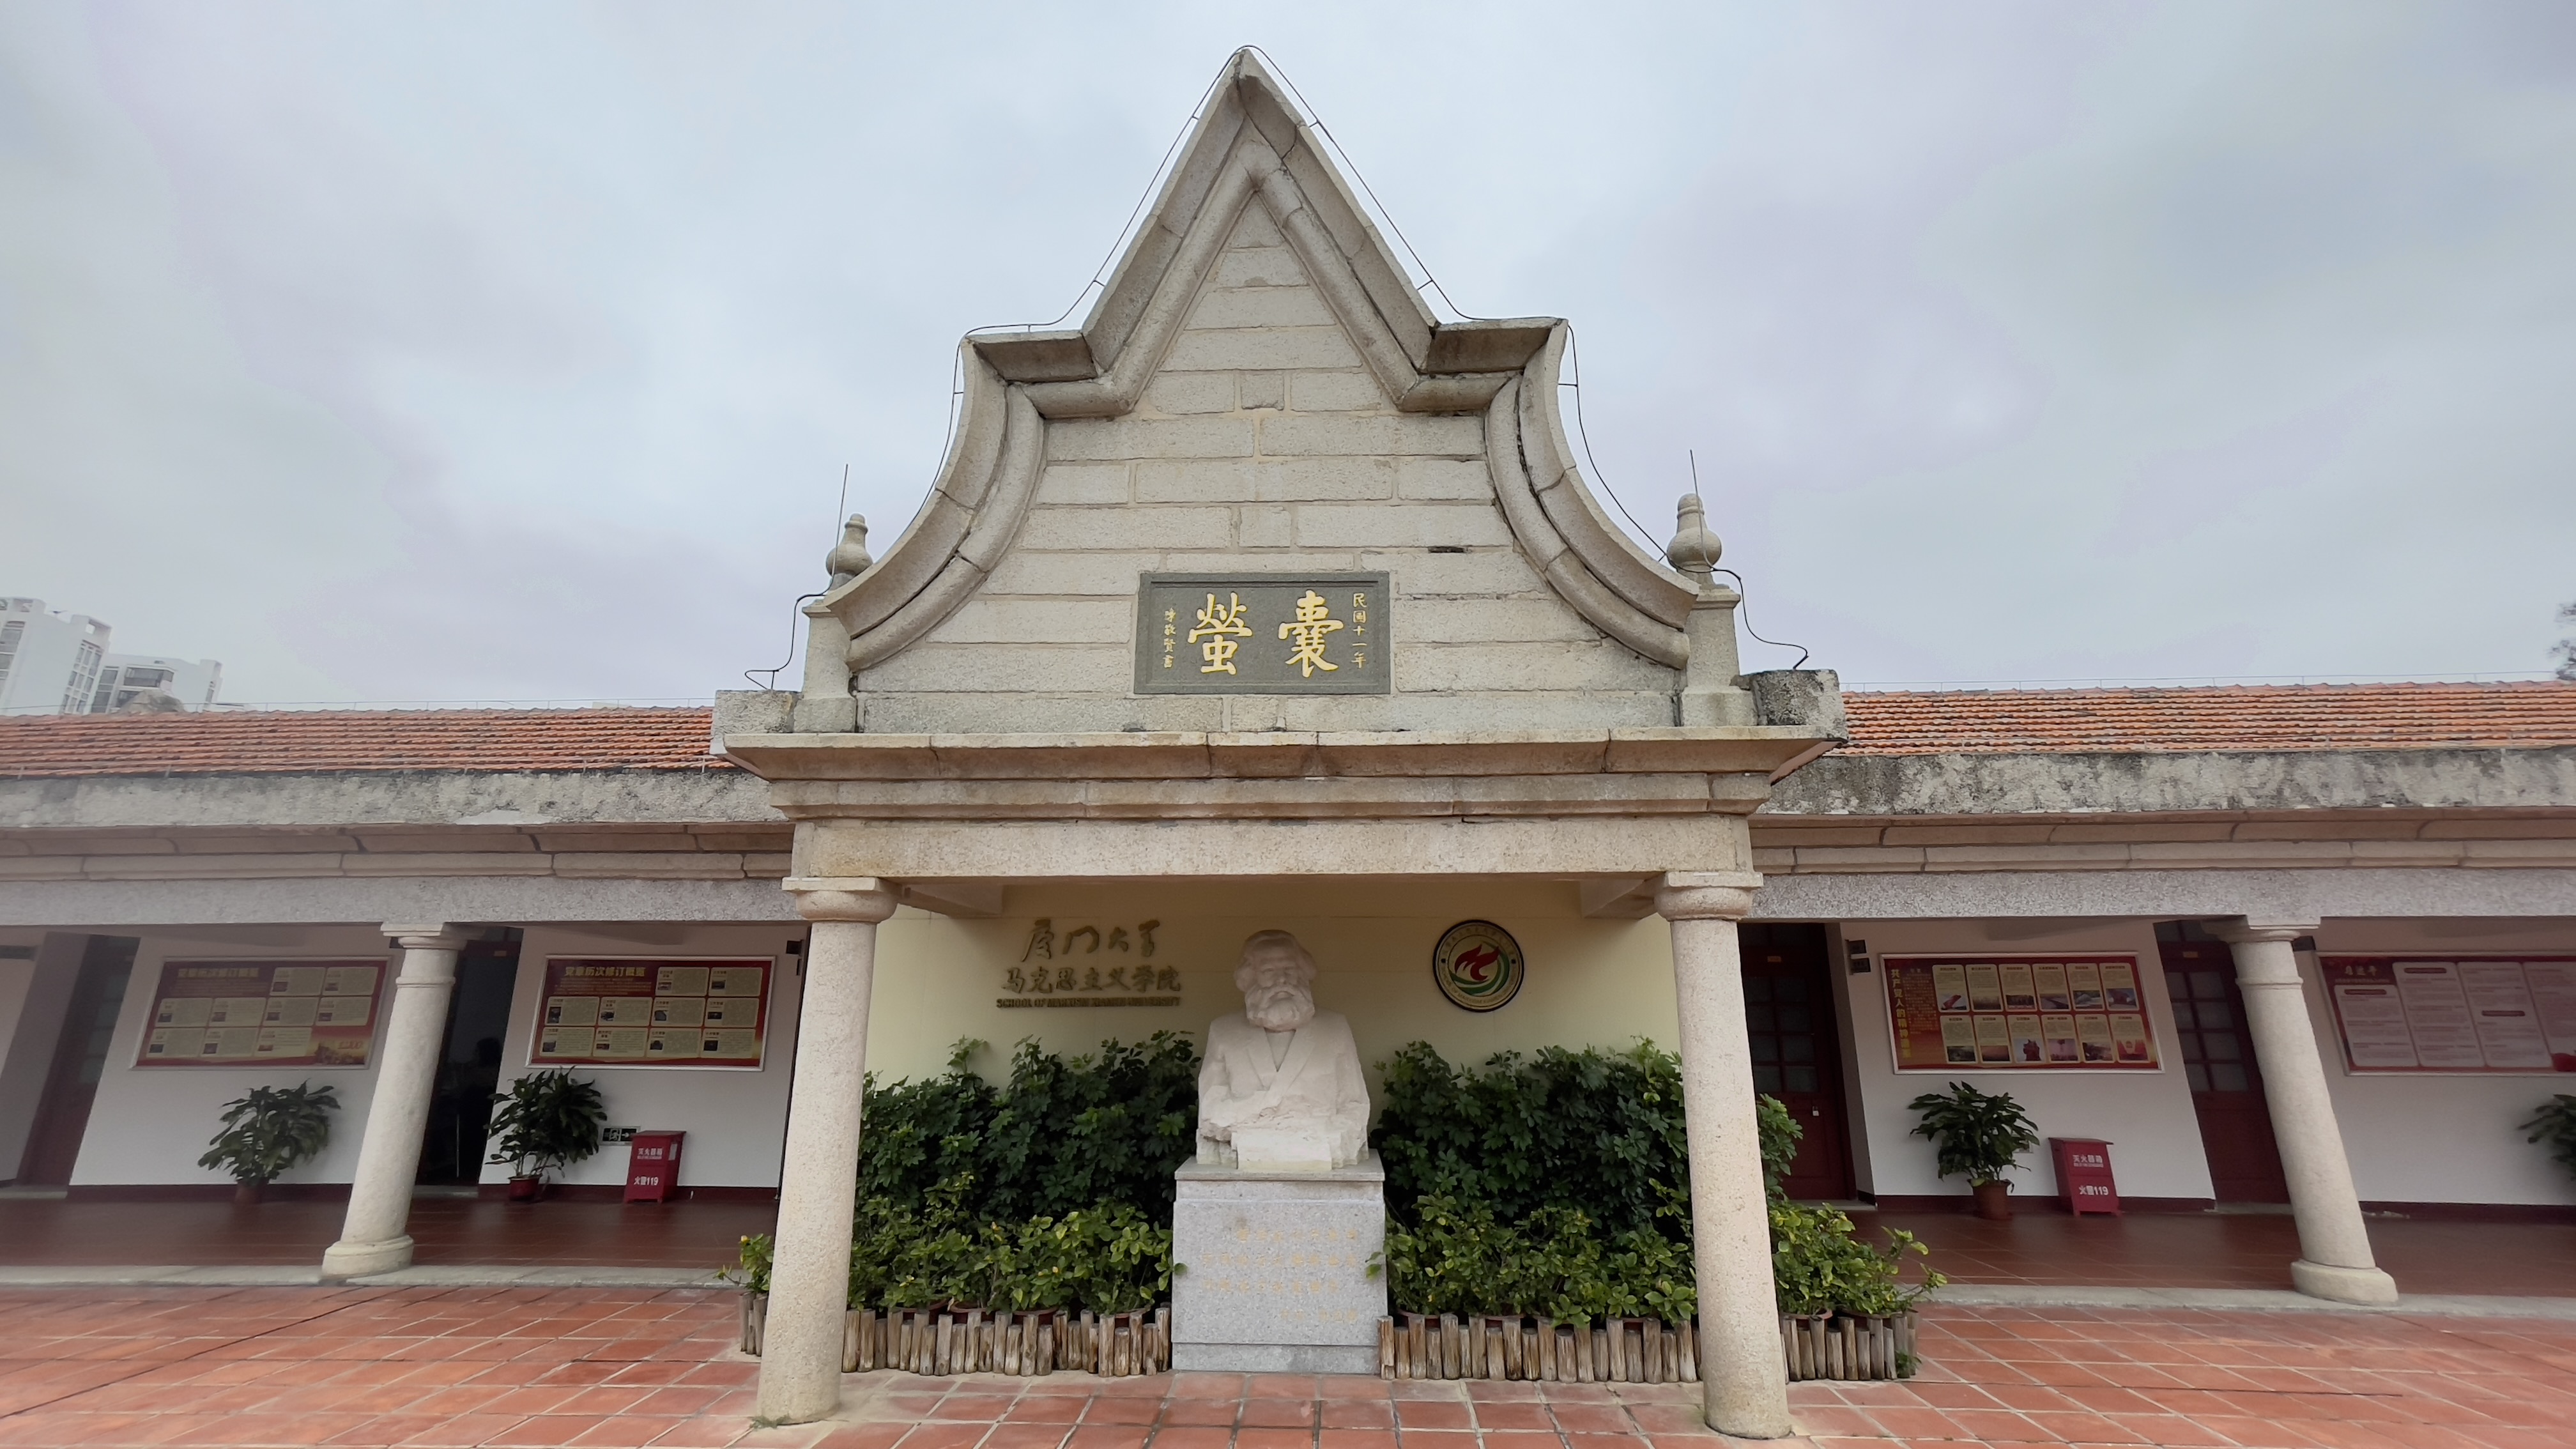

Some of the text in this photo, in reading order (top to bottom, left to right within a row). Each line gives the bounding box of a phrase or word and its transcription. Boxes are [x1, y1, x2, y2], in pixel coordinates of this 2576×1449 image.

[1001, 965, 1181, 994] 马克思主义学院
[996, 998, 1032, 1008] SCHOOL
[1034, 998, 1046, 1008] OF
